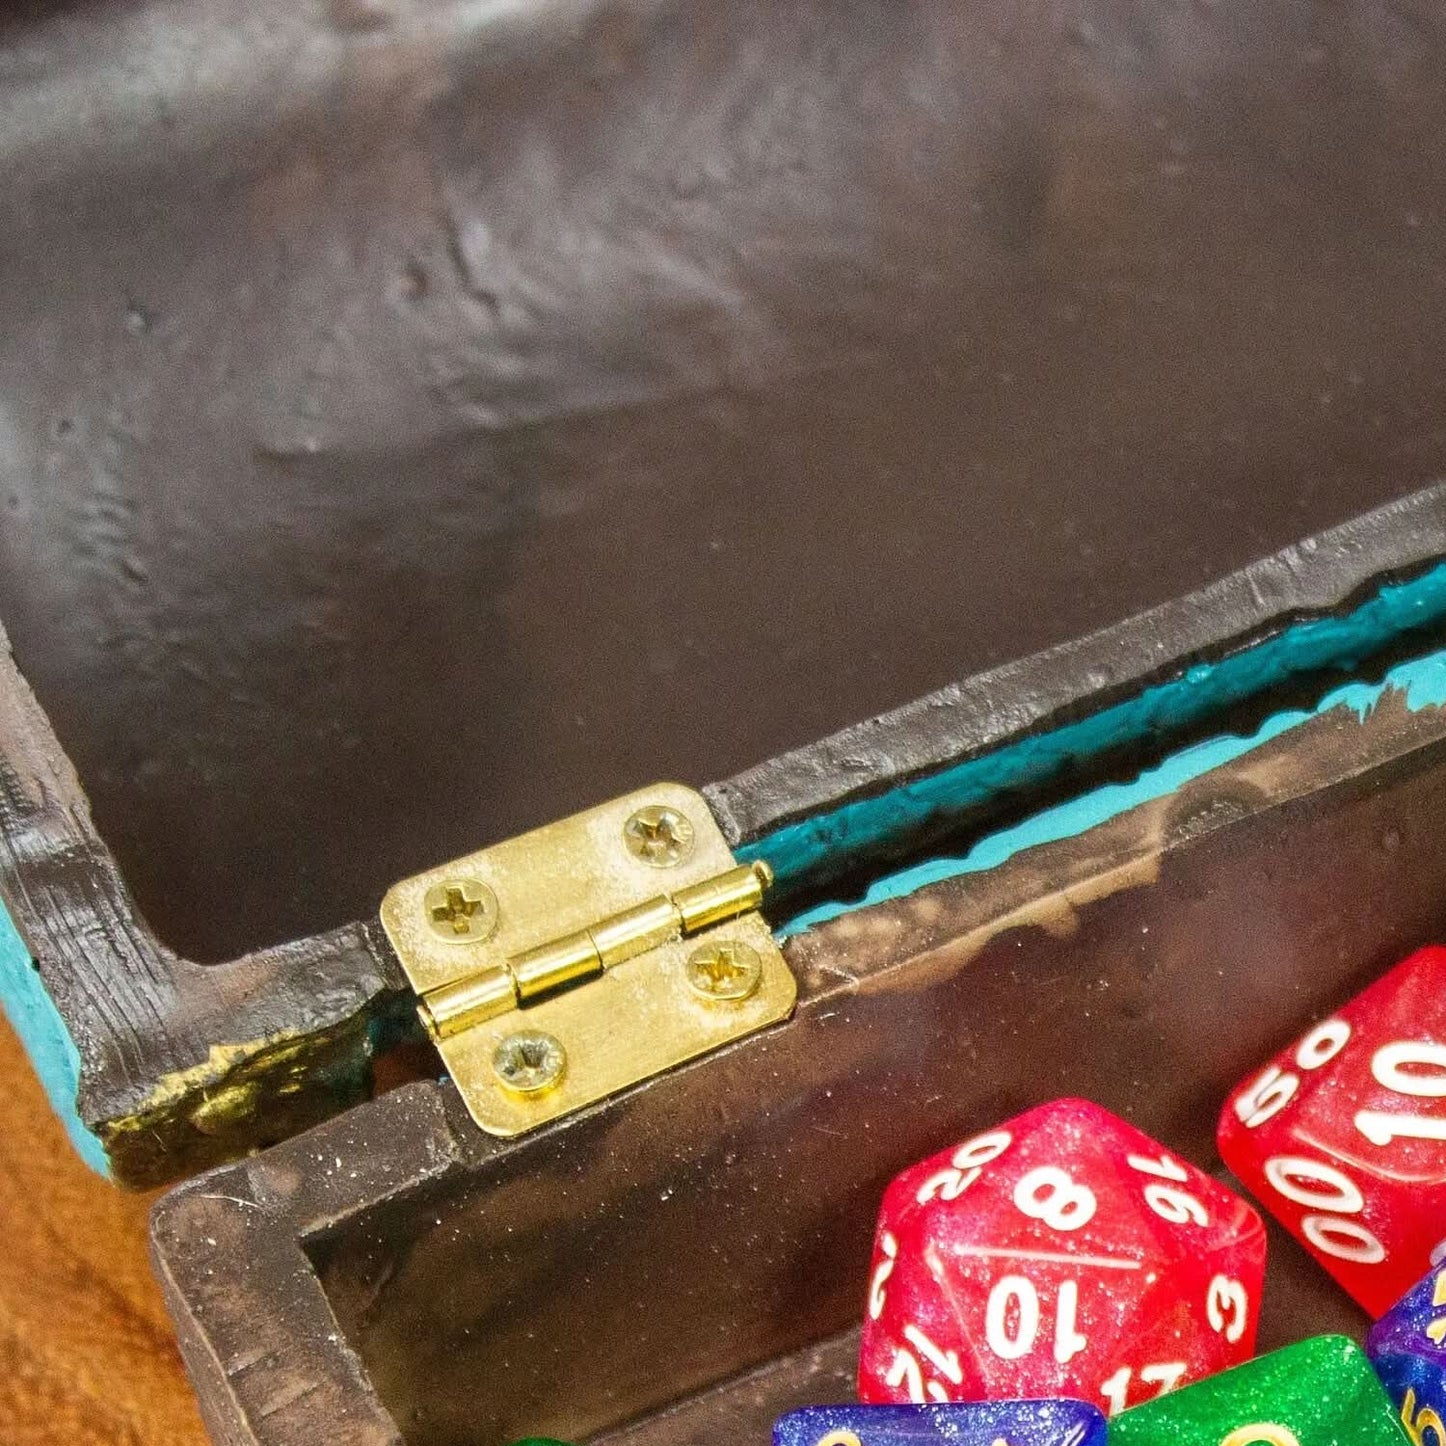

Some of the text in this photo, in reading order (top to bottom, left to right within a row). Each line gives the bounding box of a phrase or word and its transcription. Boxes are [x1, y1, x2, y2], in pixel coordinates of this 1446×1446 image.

[1234, 1019, 1351, 1128] 50
[917, 1131, 1012, 1205] 20
[1014, 1166, 1098, 1231] 8
[1264, 1156, 1386, 1264] 00
[985, 1275, 1087, 1364] 10
[1206, 1274, 1248, 1343] 3
